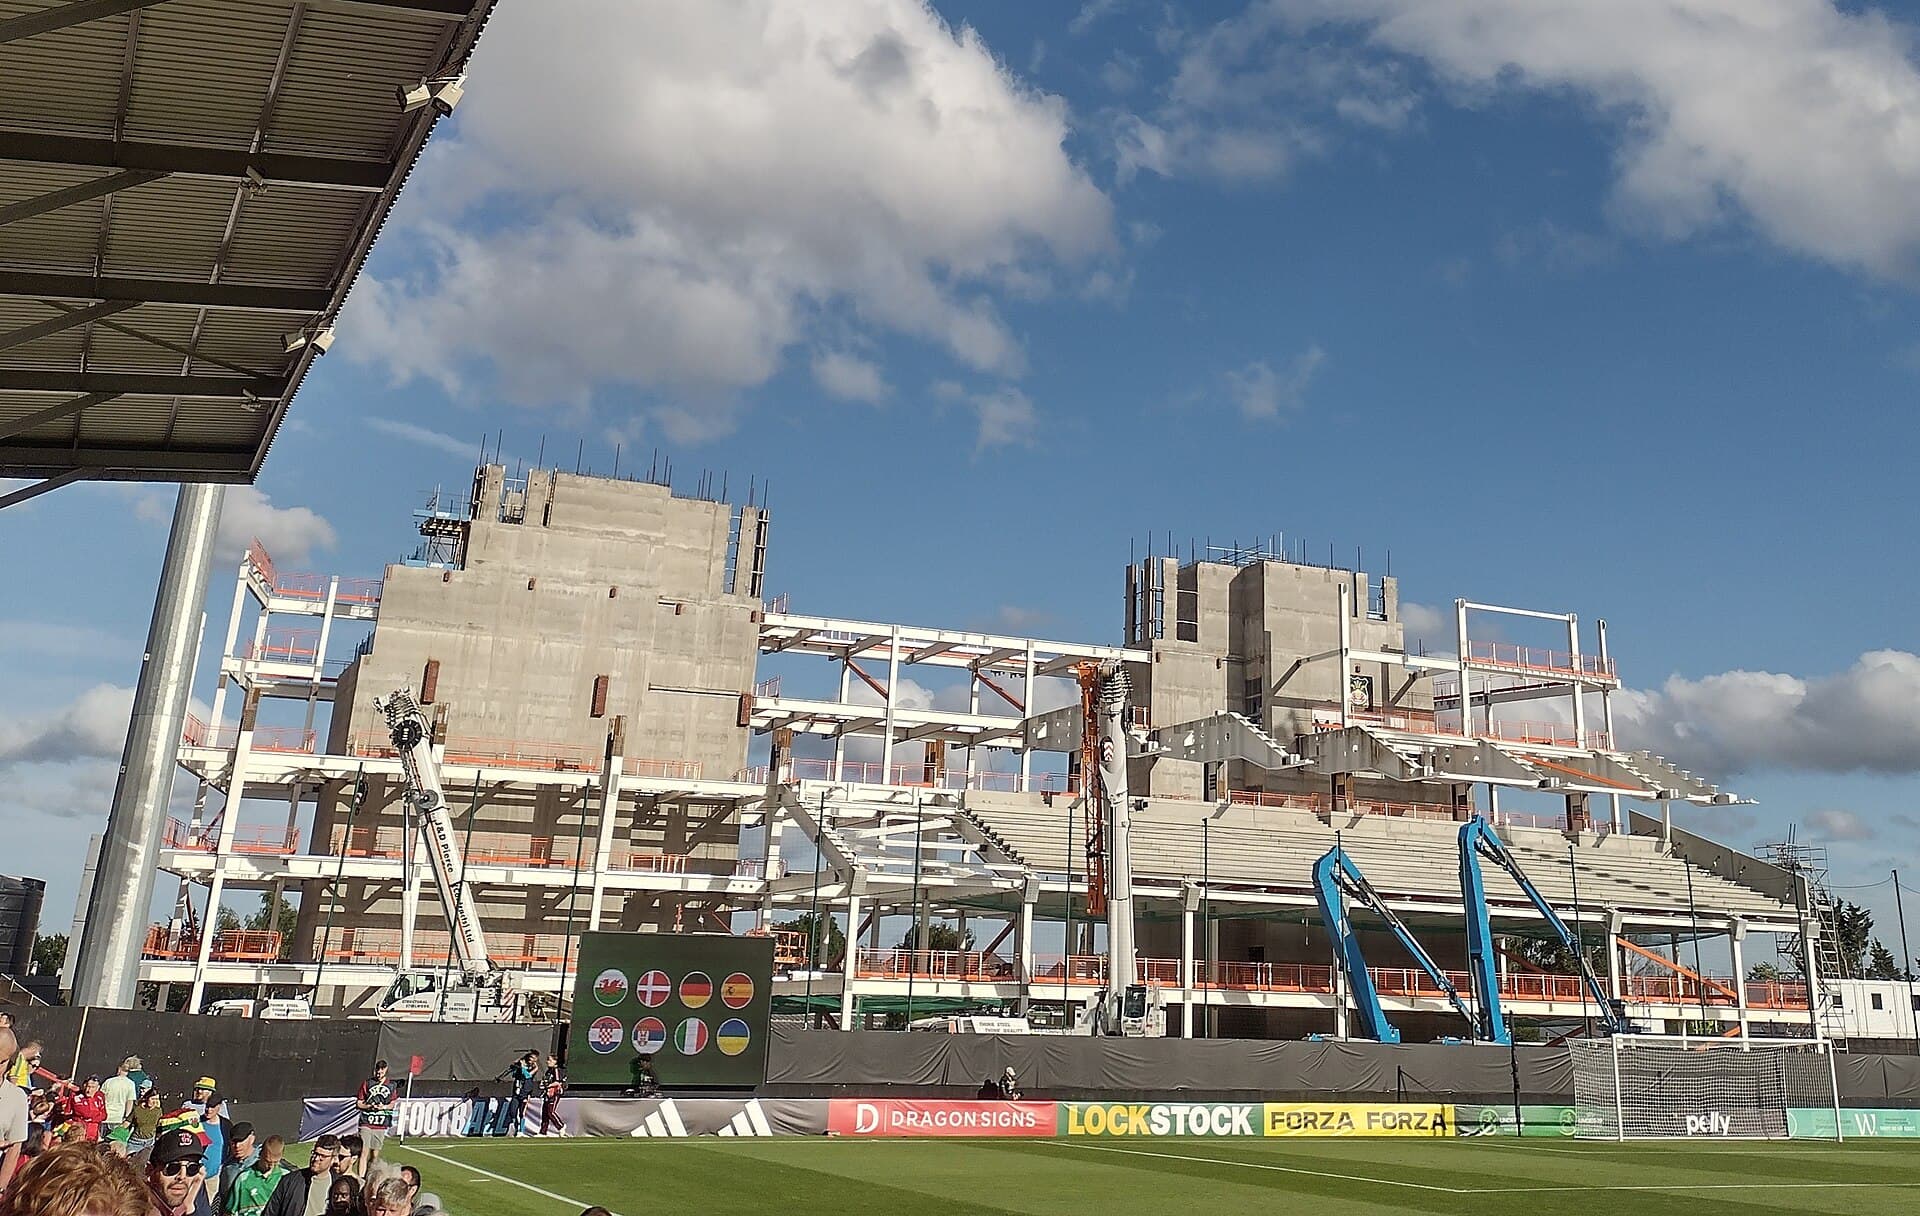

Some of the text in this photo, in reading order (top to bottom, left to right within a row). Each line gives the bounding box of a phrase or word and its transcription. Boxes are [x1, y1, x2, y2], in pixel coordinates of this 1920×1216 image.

[465, 929, 475, 943] Ltd
[367, 1115, 386, 1125] 917
[891, 1110, 1037, 1128] DRAGON SIGNS
[1067, 1104, 1255, 1136] LOCKSTOCK
[1270, 1111, 1448, 1131] FORZA FORZA
[1685, 1111, 1731, 1136] pelly
